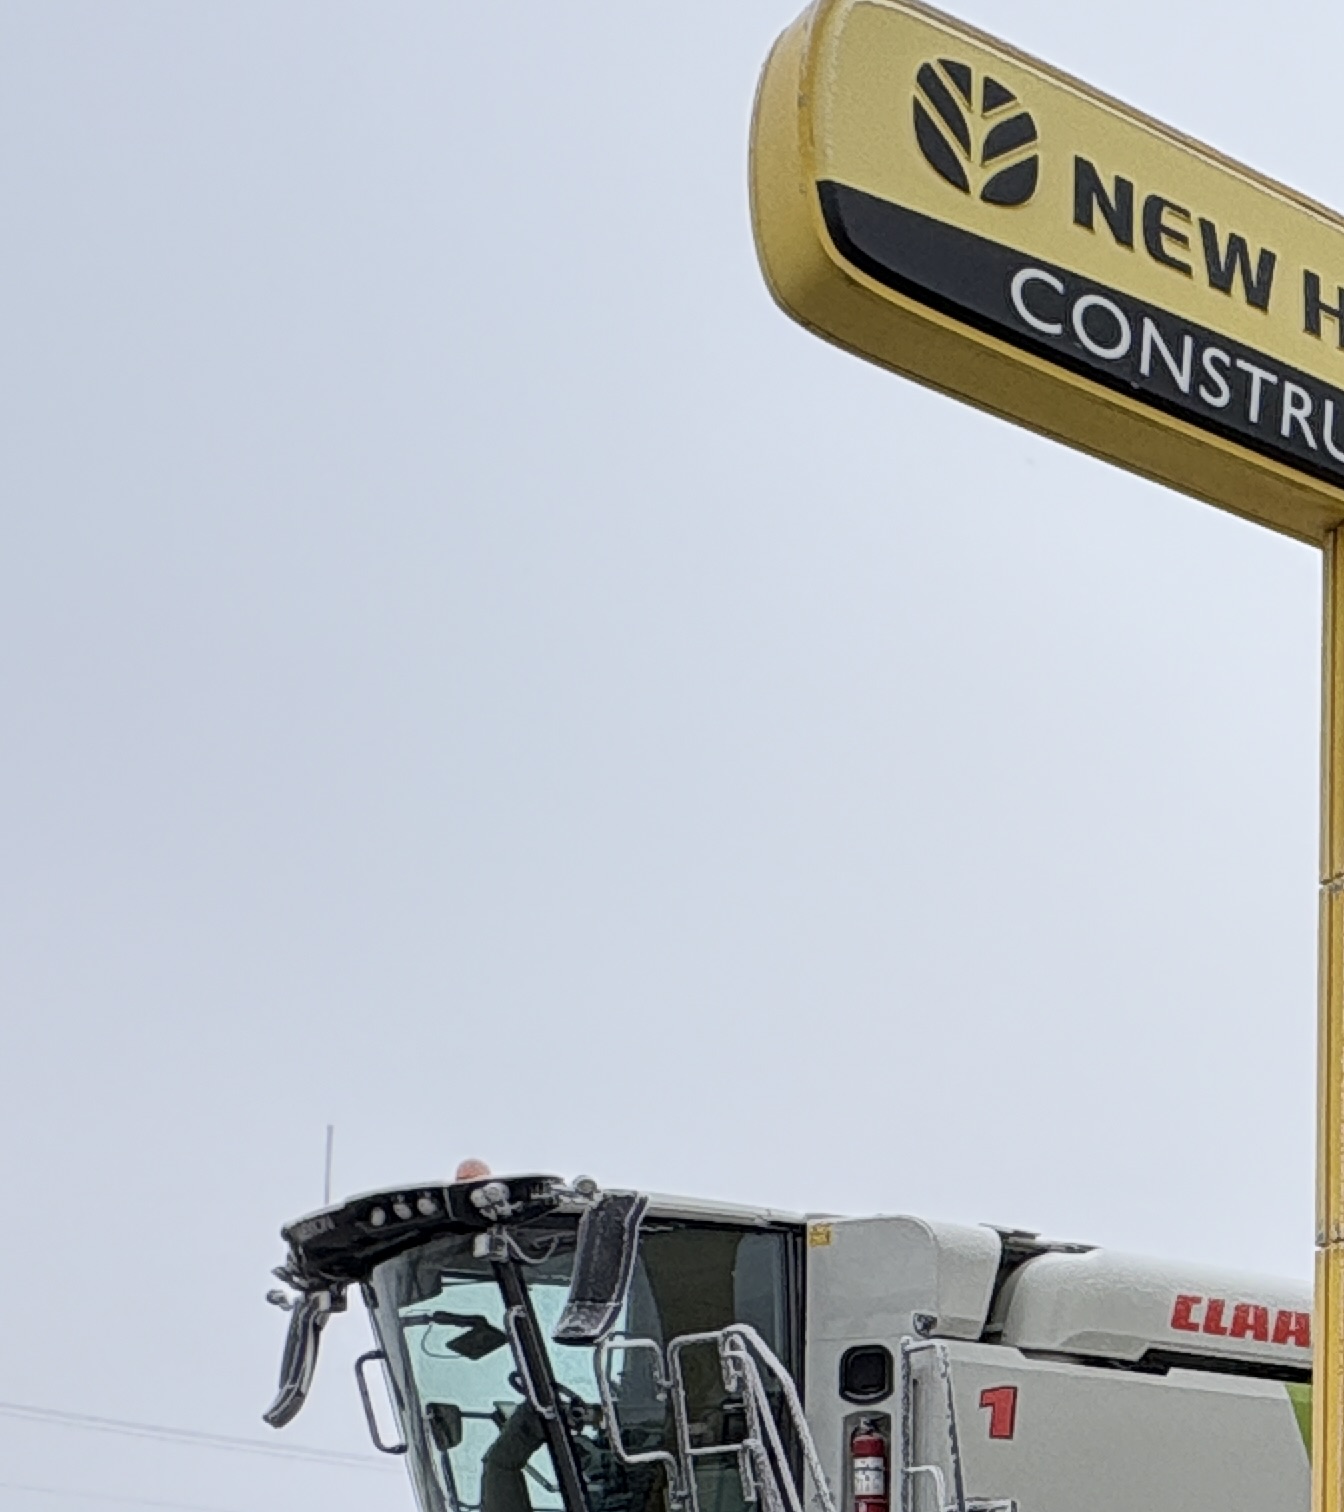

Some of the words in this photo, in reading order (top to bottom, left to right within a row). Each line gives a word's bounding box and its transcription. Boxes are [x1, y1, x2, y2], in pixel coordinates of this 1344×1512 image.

[1073, 153, 1277, 315] NEW
[1171, 1295, 1310, 1348] CLAA
[979, 1386, 1018, 1440] 1
